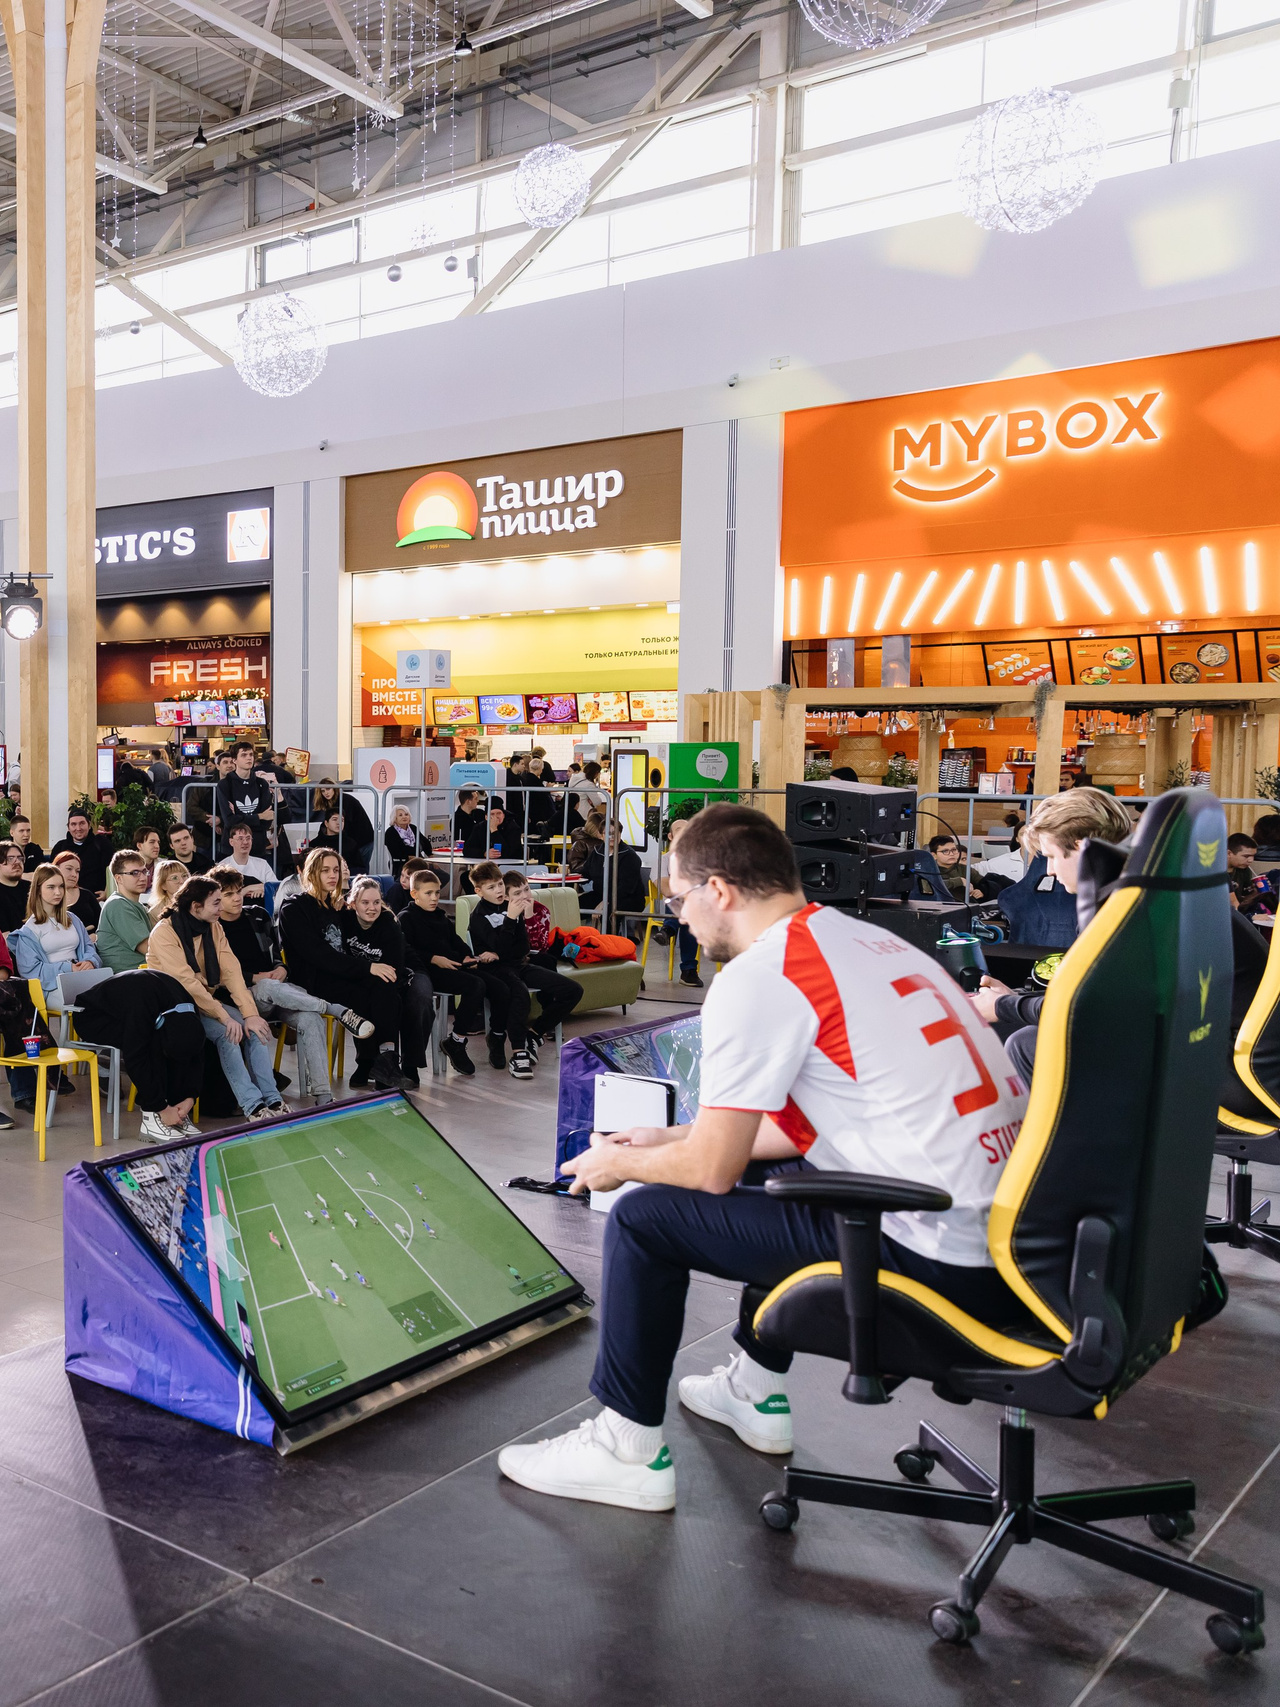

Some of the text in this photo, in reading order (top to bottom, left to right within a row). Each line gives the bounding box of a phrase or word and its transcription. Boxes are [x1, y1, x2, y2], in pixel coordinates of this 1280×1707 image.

[893, 390, 1163, 472] MYBOX
[476, 469, 624, 513] Ташир
[480, 505, 597, 539] пицца
[186, 638, 263, 651] ALWAYS COOKED
[641, 636, 671, 644] ТОЛЬКО
[614, 649, 669, 657] НАТУРАЛЬНЫЕ
[150, 656, 268, 685] FRESH
[372, 691, 418, 703] ВМЕСТЕ
